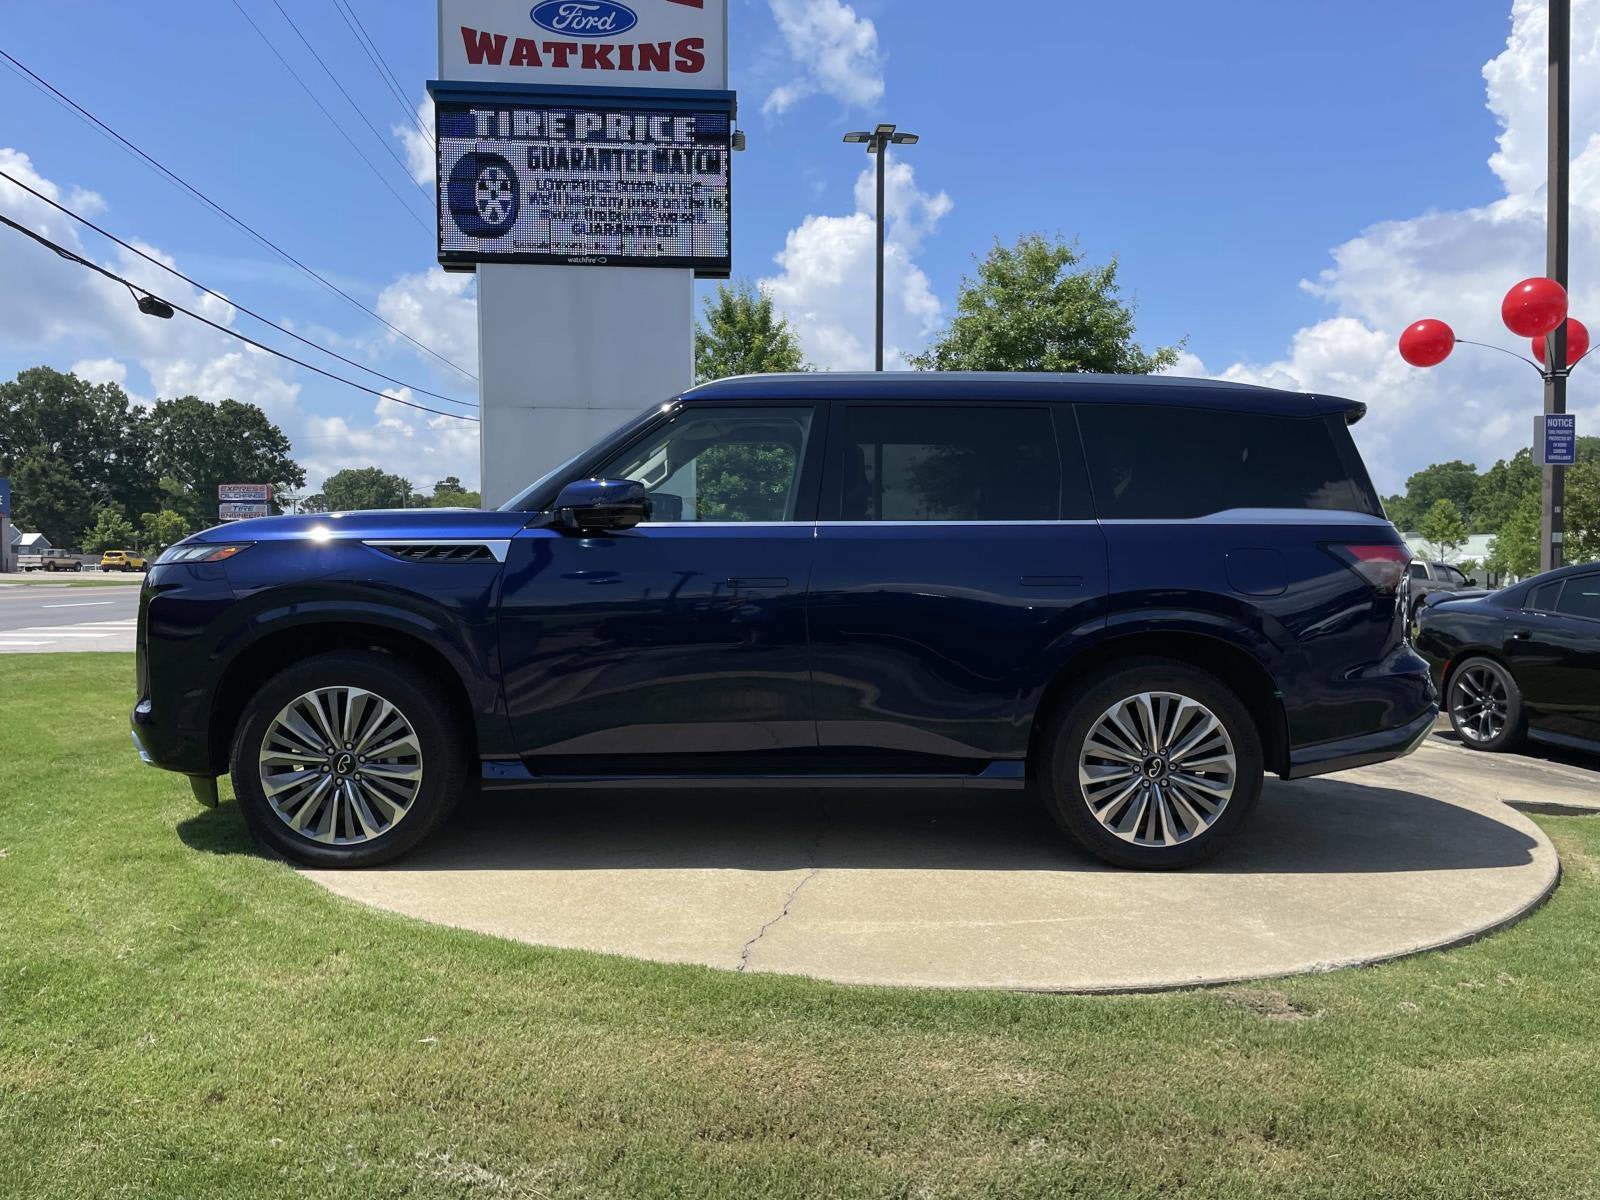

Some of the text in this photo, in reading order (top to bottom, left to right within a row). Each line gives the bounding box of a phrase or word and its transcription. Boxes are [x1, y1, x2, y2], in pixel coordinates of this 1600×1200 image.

[552, 3, 616, 30] Ford
[460, 26, 705, 73] WATKINS
[470, 109, 696, 141] TIRE PRICE
[527, 145, 721, 174] GUARANTEE MATCH
[570, 178, 611, 192] PRICE
[571, 223, 678, 238] GUARANTEED!
[567, 256, 597, 264] watchfire
[1547, 418, 1573, 427] NOTICE
